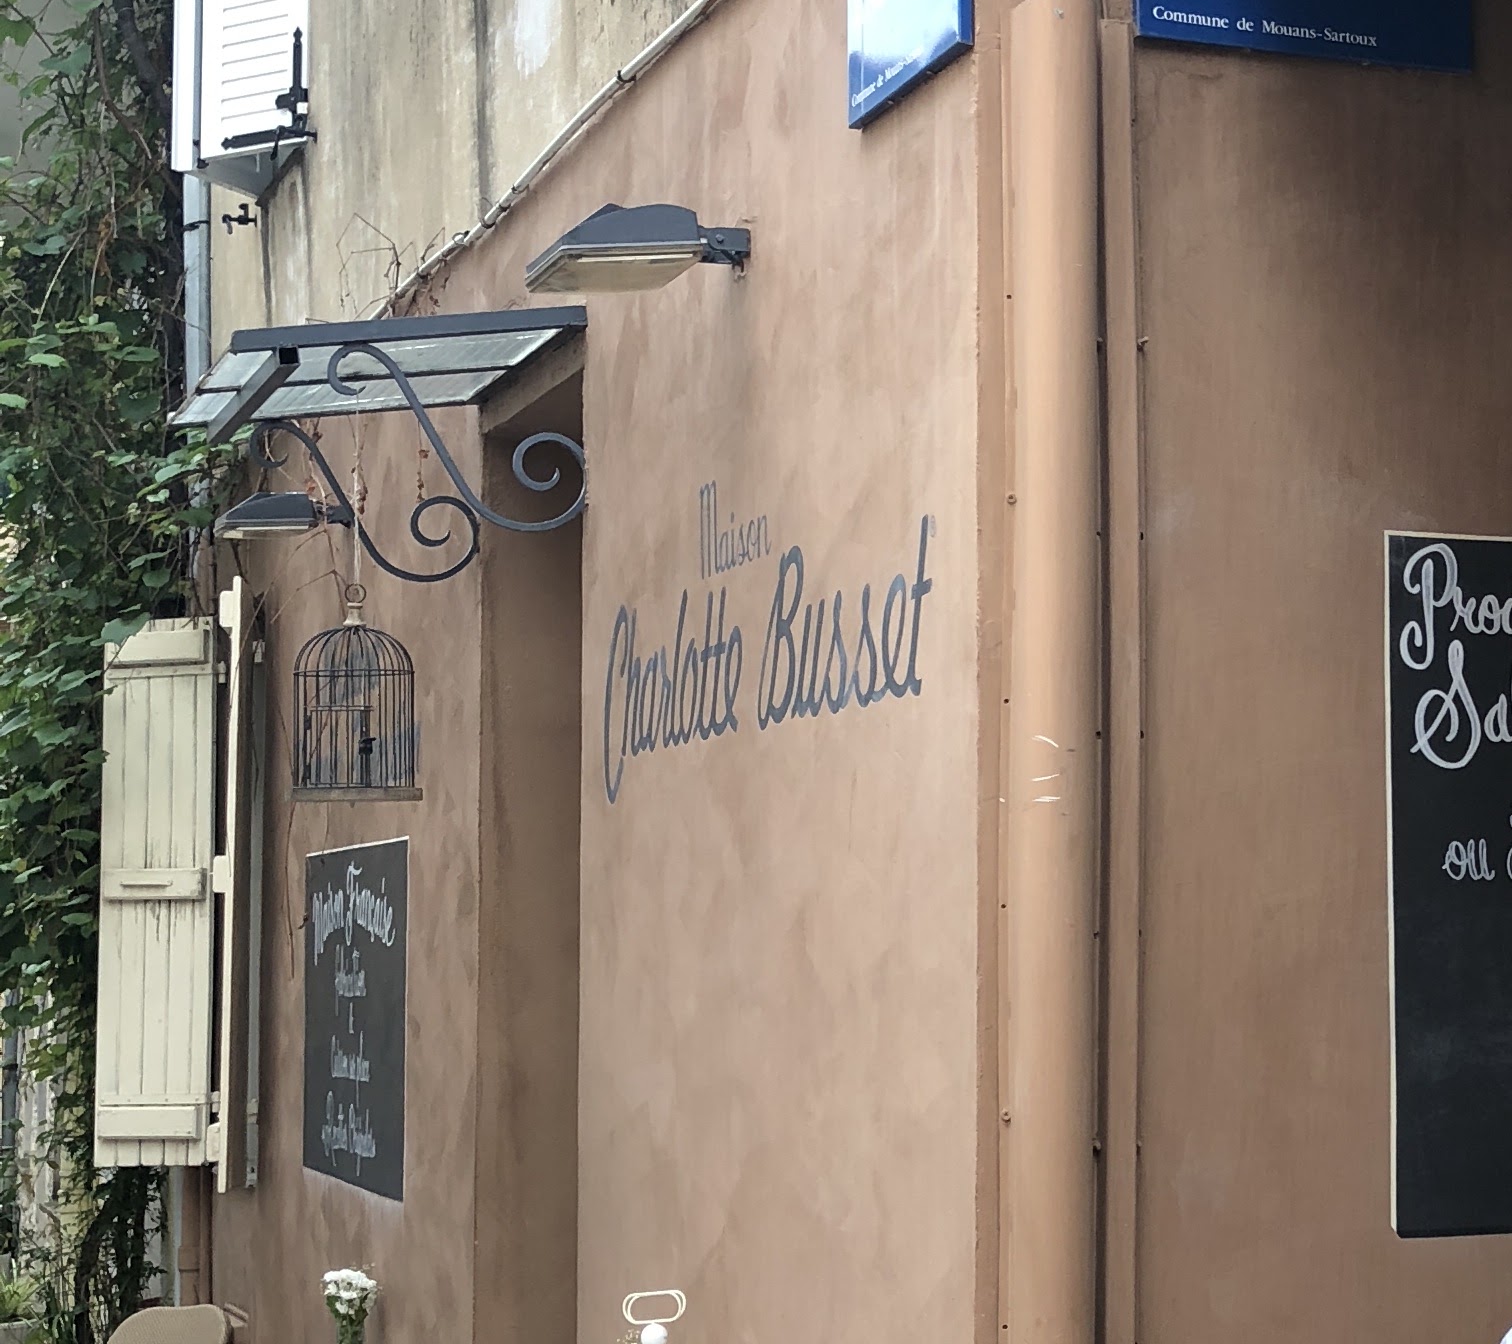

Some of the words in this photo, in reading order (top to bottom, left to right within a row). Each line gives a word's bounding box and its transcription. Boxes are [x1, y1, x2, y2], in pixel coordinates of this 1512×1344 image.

[1152, 5, 1231, 30] Commune
[1237, 16, 1254, 33] de
[1261, 19, 1378, 48] Mouans-Sartoux
[700, 479, 772, 580] Maison
[604, 587, 743, 805] Charlotte
[757, 514, 933, 731] Busset
[1442, 837, 1496, 881] ou
